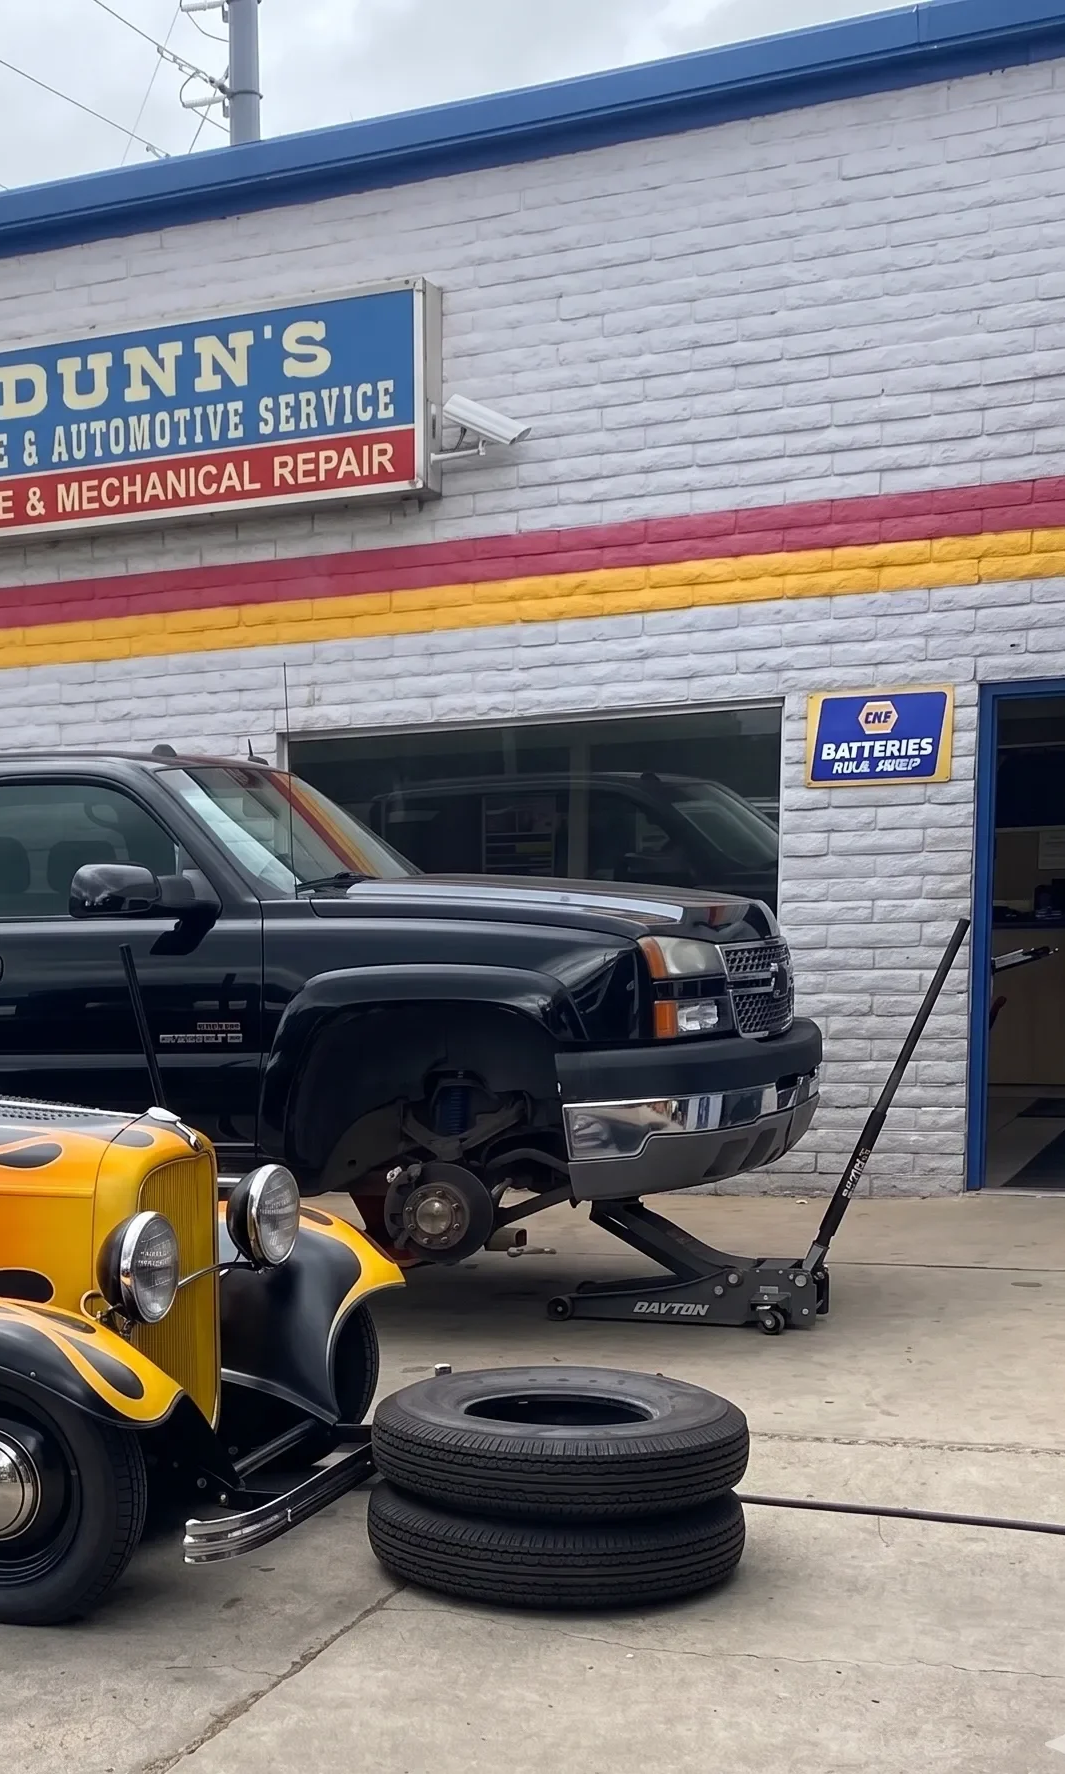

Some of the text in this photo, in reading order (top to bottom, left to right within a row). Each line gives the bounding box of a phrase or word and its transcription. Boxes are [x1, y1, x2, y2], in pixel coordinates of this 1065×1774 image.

[23, 436, 37, 465] &
[52, 401, 243, 461] AUTOMOTIVE
[259, 380, 394, 434] SERVICE
[26, 487, 45, 516] &
[57, 459, 261, 513] MECHANICAL
[273, 443, 394, 484] REPAIR
[821, 738, 933, 760] BATTERIES
